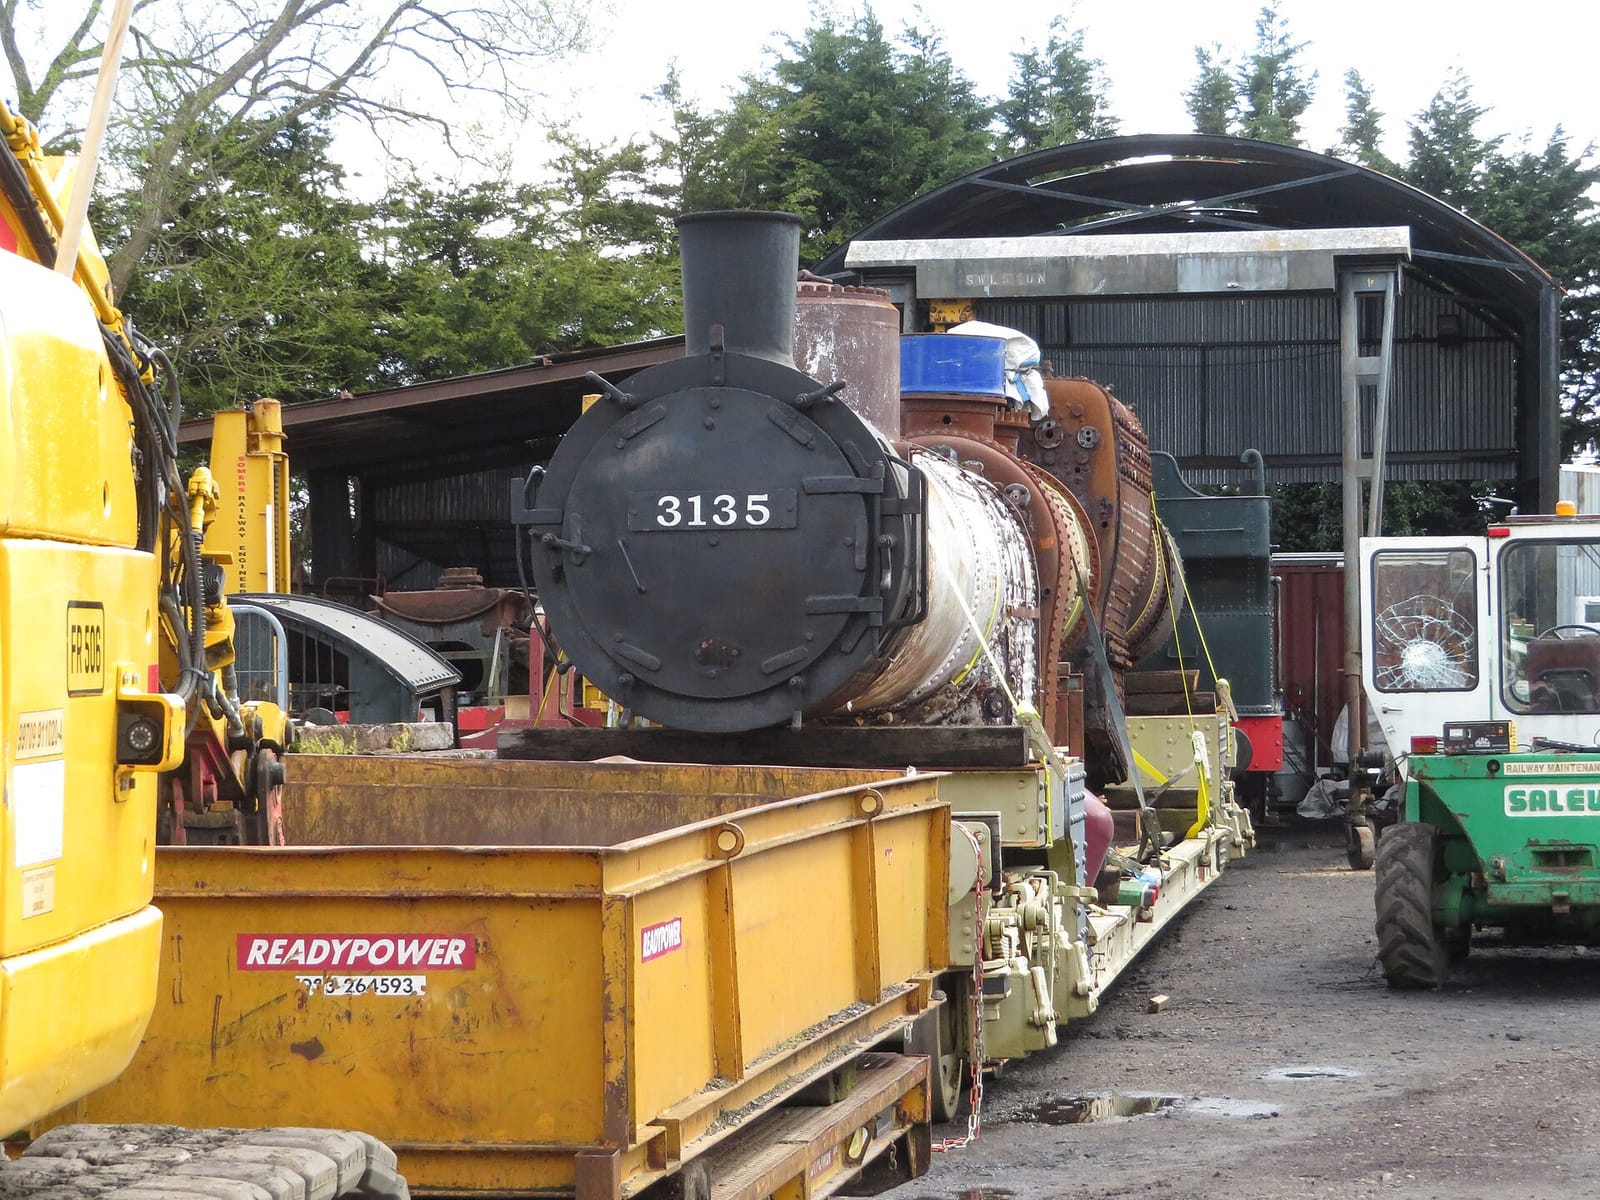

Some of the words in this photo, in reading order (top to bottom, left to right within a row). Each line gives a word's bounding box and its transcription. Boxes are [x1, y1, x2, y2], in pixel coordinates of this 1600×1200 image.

[237, 456, 246, 492] SOMERS
[237, 495, 247, 538] RAILWAY
[656, 494, 770, 526] 3135
[71, 624, 82, 673] FR
[84, 624, 100, 673] 506
[1506, 764, 1544, 774] RAILWAY
[246, 938, 467, 966] READYPOWER
[643, 919, 681, 958] READYPOWER
[343, 977, 414, 994] 264593
